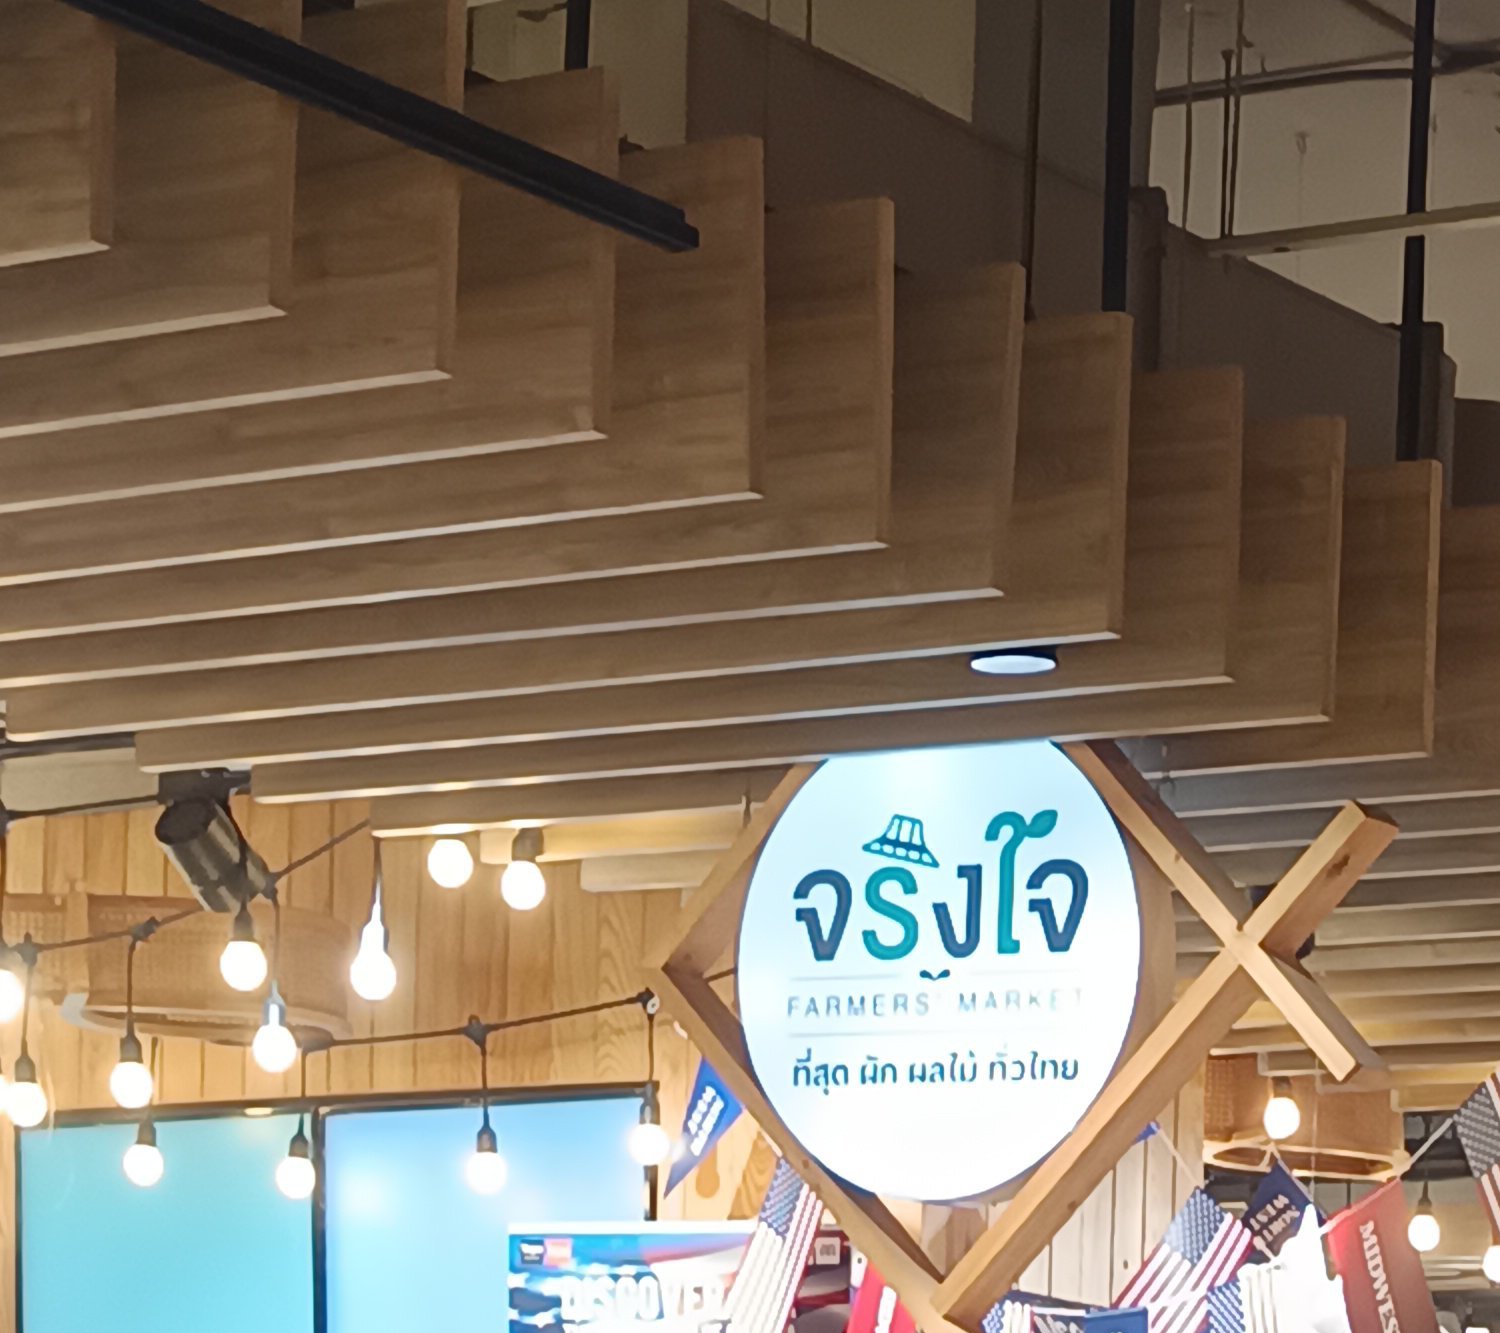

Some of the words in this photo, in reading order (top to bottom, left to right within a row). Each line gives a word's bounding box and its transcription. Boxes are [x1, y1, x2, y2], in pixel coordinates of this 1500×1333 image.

[959, 988, 1082, 1013] MARKET
[793, 1048, 849, 1096] ที่สุด
[860, 1055, 898, 1085] ผัก
